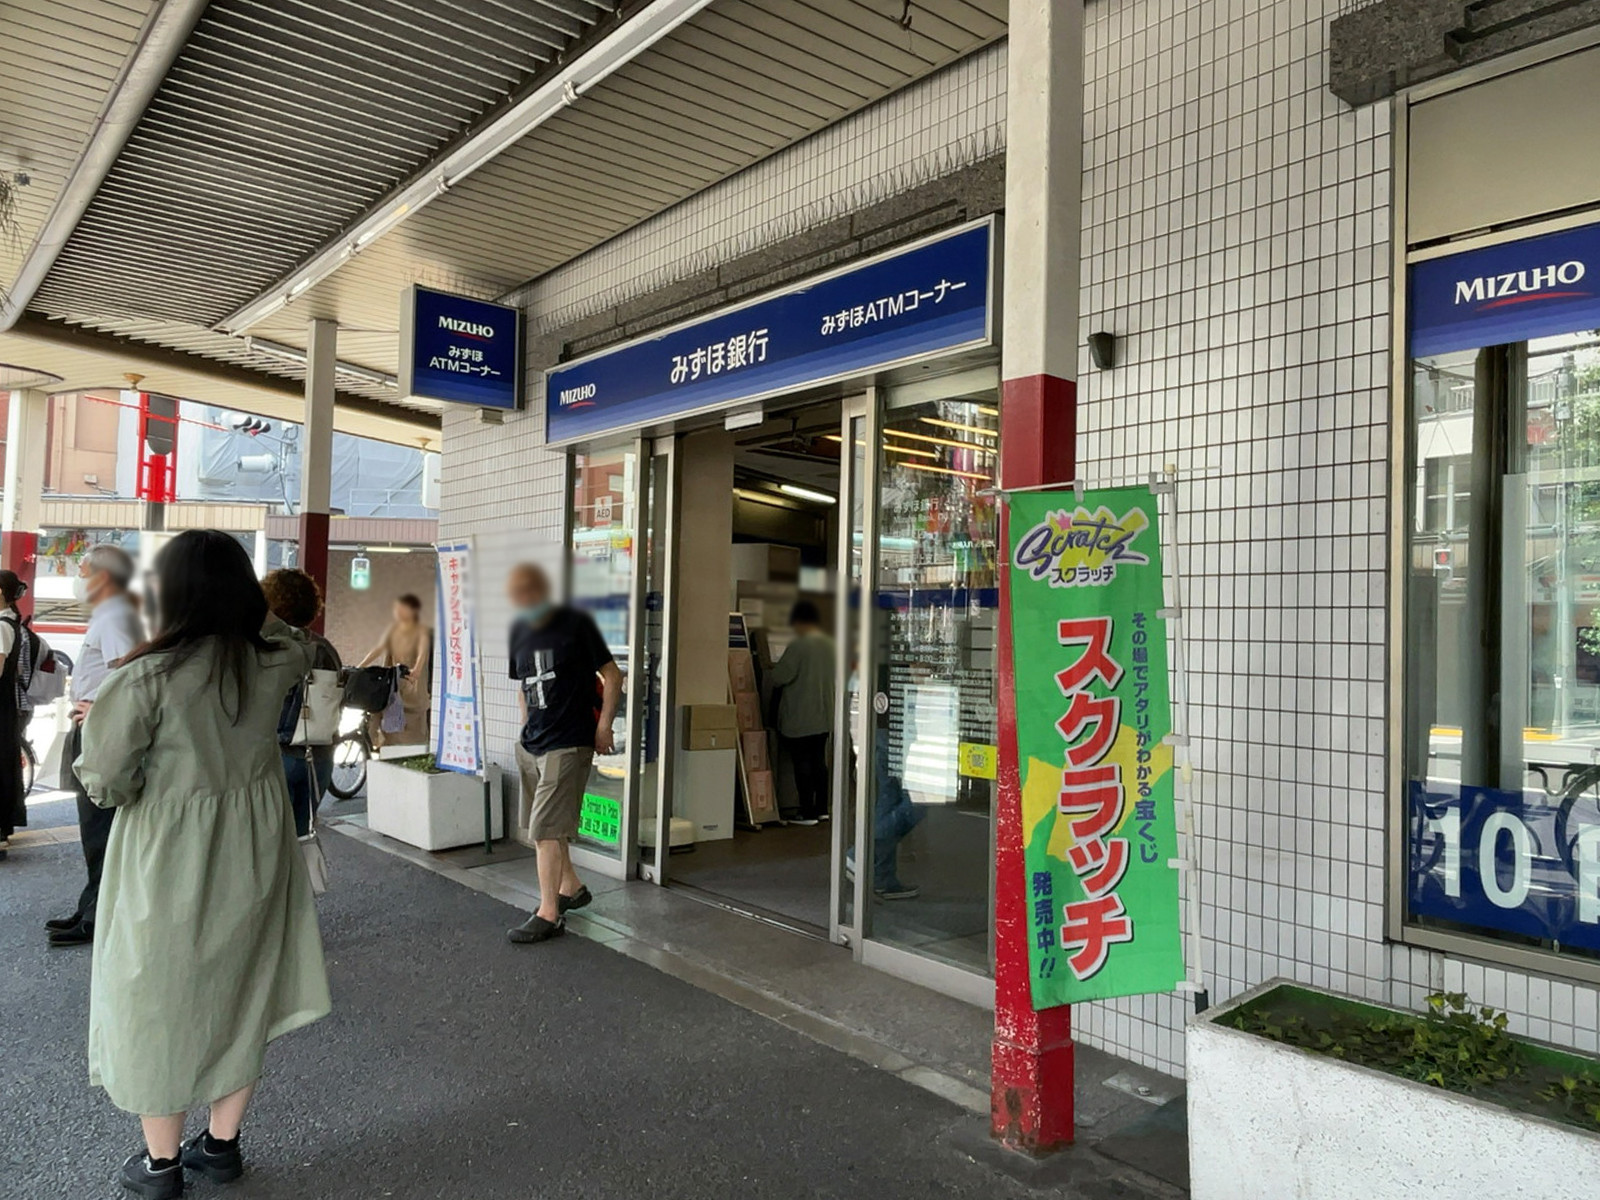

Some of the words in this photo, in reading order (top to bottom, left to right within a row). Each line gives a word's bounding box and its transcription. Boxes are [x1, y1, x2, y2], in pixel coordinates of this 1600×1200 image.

[1455, 260, 1586, 305] MIZUHO
[821, 279, 967, 336] みずほATMコーナー
[438, 316, 495, 338] MIZUHO
[429, 356, 501, 377] ATMコーナー
[448, 345, 484, 363] みずほ
[670, 328, 769, 384] みずほ銀行
[559, 383, 596, 406] MIZUHO
[596, 508, 611, 519] AED
[1017, 517, 1146, 576] Scratch
[1051, 565, 1114, 584] スクラッチ
[1132, 612, 1159, 864] その場でアタリがわかる宝くじ
[1055, 616, 1131, 978] スクラッチ
